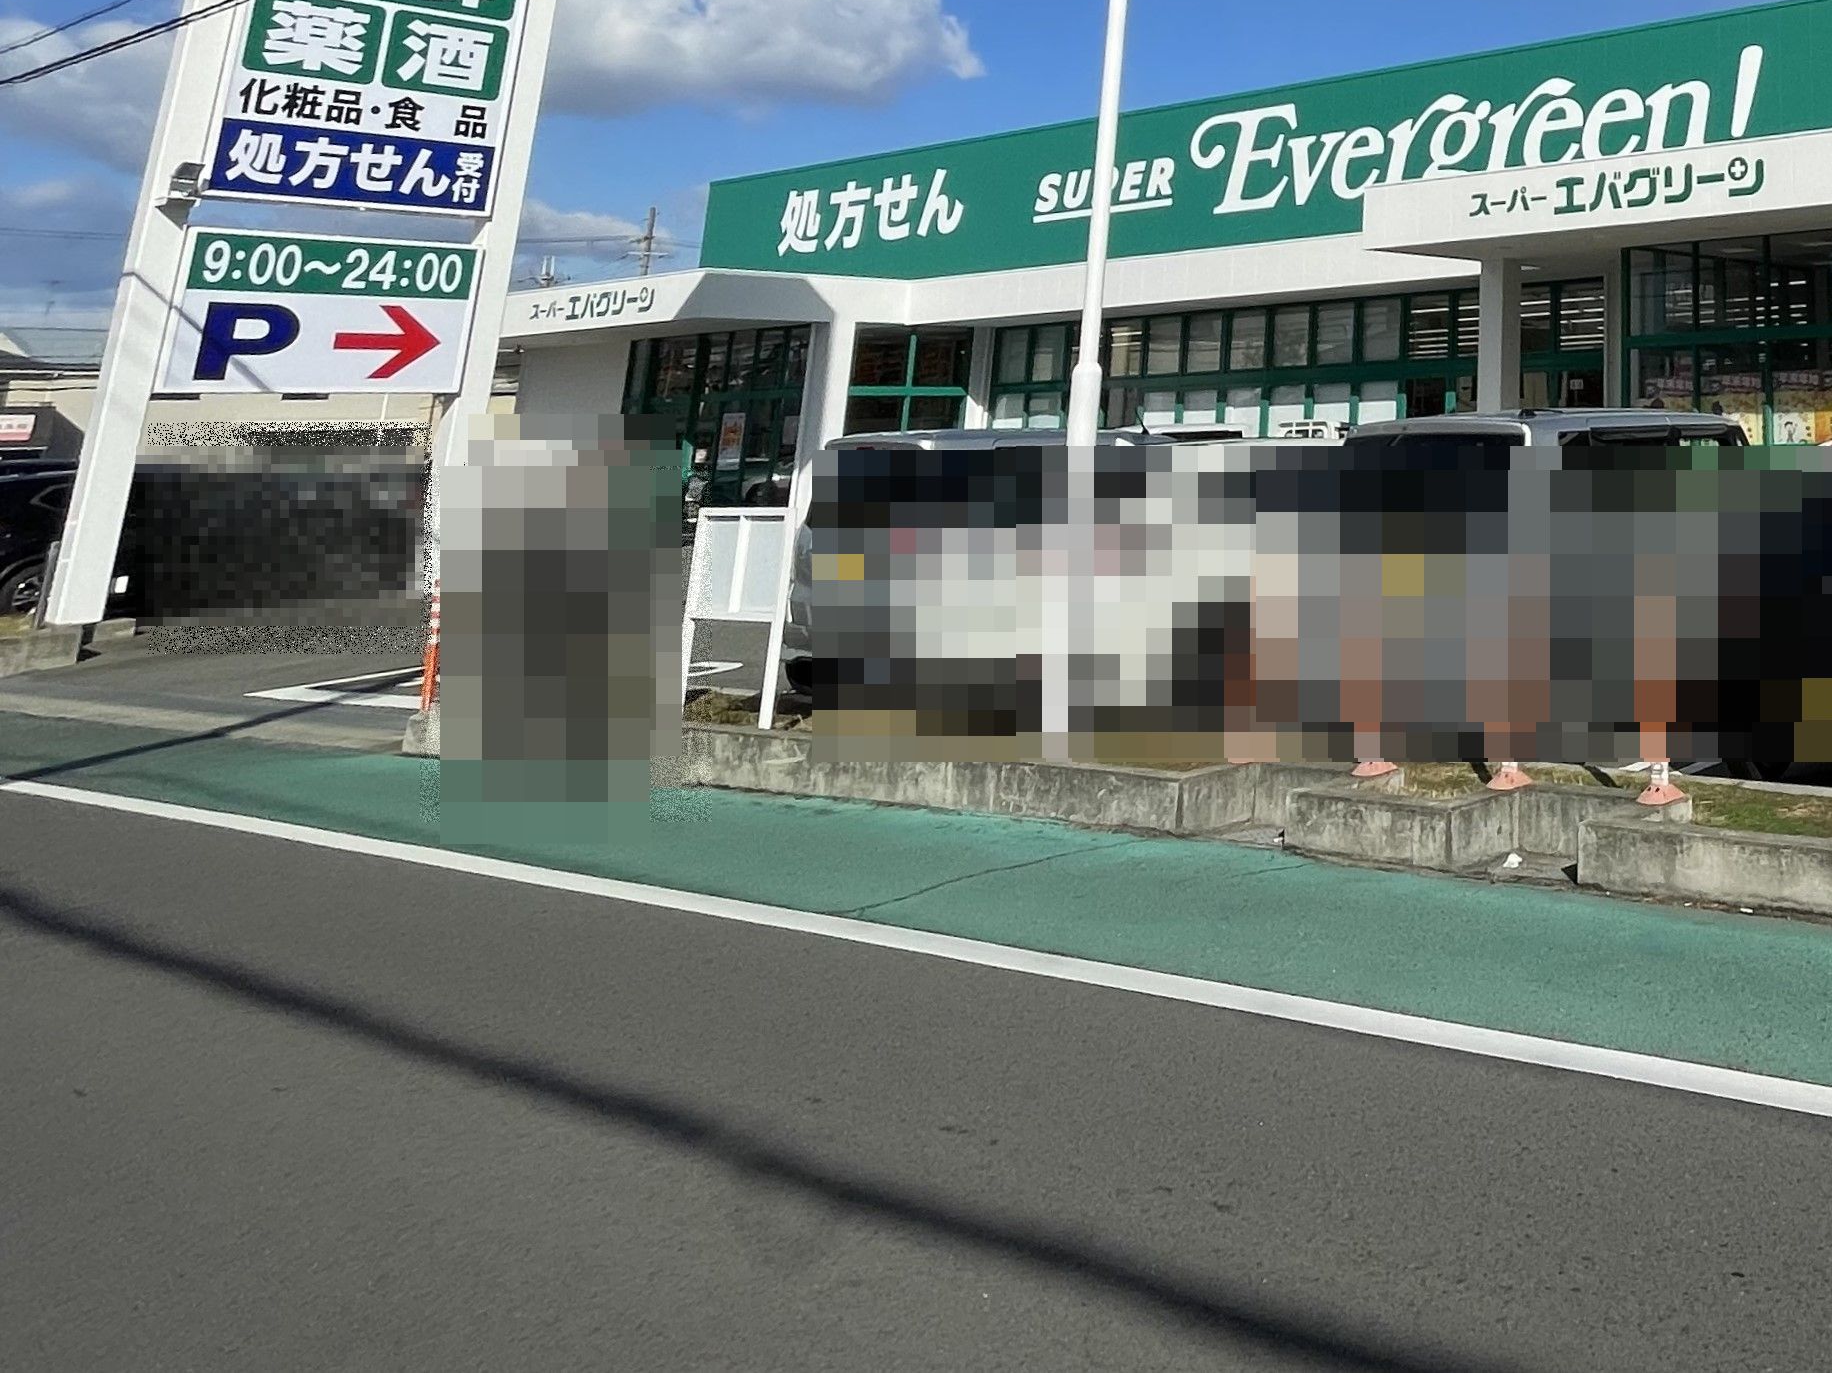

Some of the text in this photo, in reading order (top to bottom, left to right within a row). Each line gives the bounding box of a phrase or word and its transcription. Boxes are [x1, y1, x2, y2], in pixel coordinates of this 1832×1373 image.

[262, 0, 495, 92] 薬 酒
[225, 128, 485, 204] 処方せん 受付
[1468, 156, 1765, 218] スーパー エバグリーン
[776, 167, 965, 257] 処方せん
